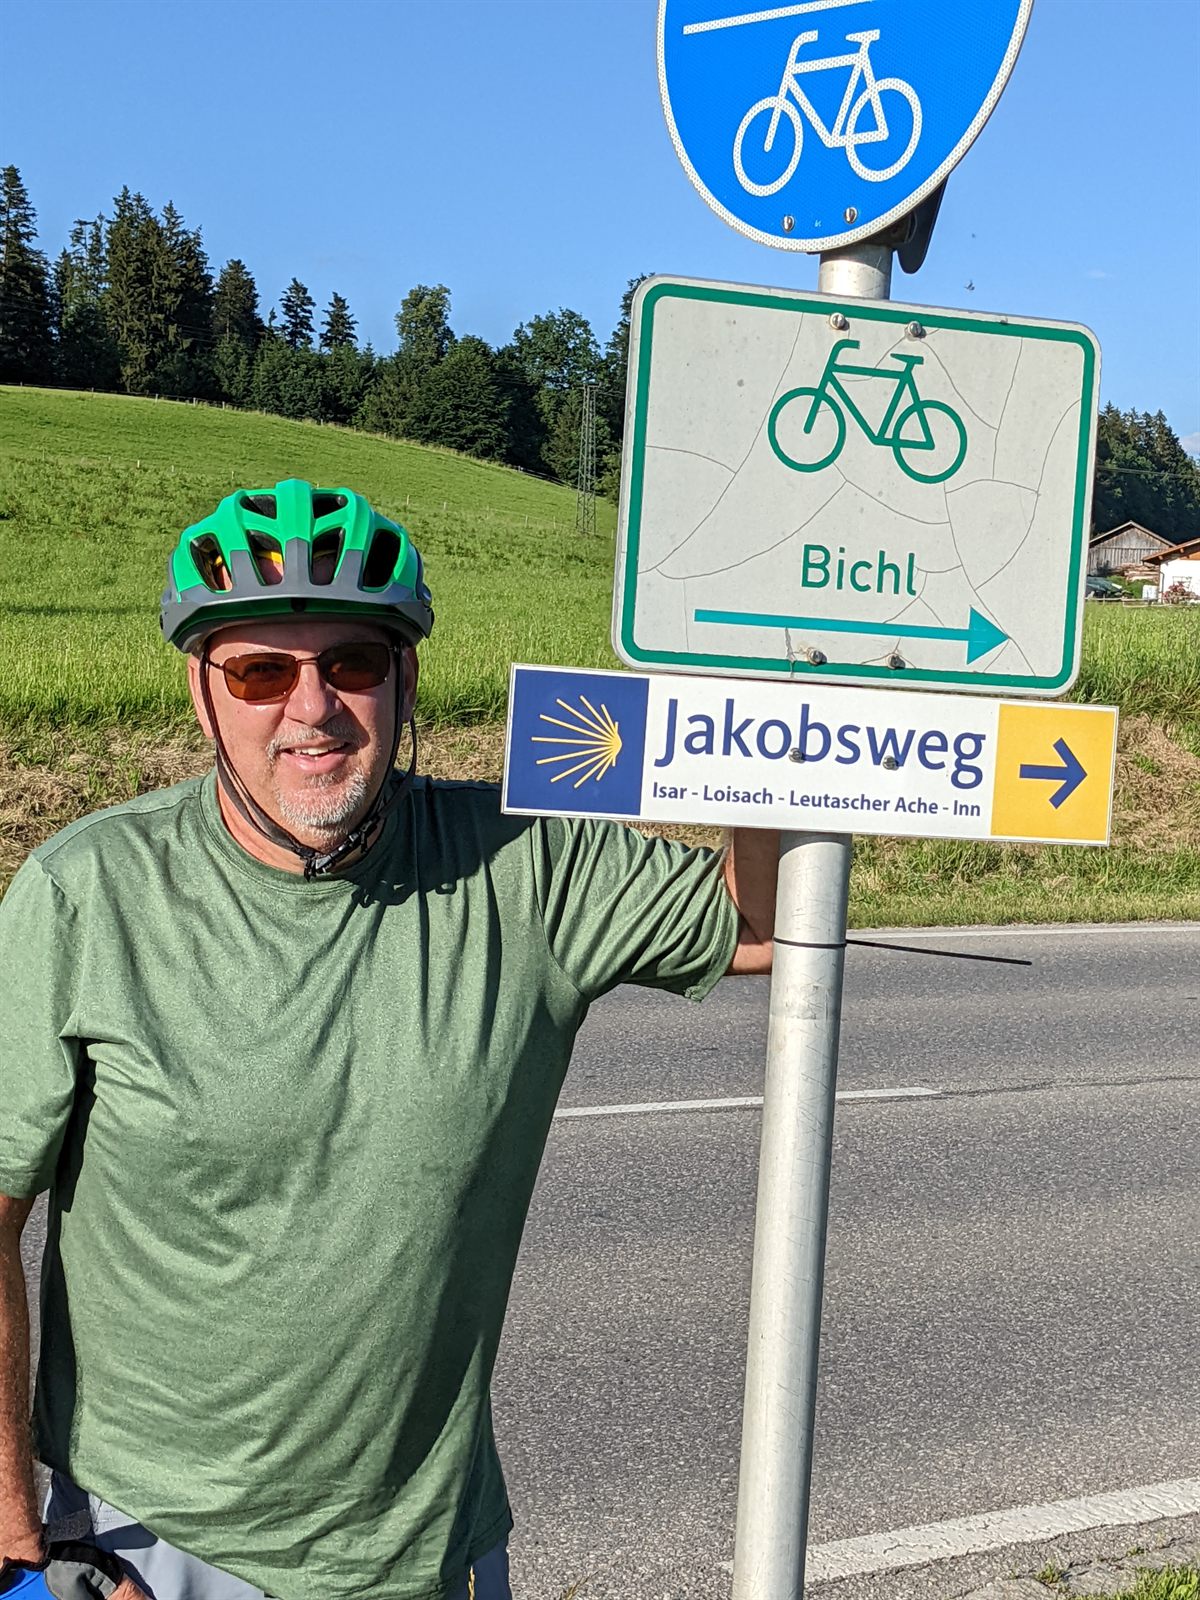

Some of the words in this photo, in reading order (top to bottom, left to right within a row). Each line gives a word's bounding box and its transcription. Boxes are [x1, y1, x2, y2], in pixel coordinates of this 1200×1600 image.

[801, 543, 917, 596] Bichl
[653, 697, 986, 789] Jakobsweg
[653, 782, 687, 799] Isar
[703, 785, 773, 804] Loisach
[789, 789, 890, 812] Leutascher
[895, 796, 939, 815] Ache
[953, 800, 981, 817] Inn
